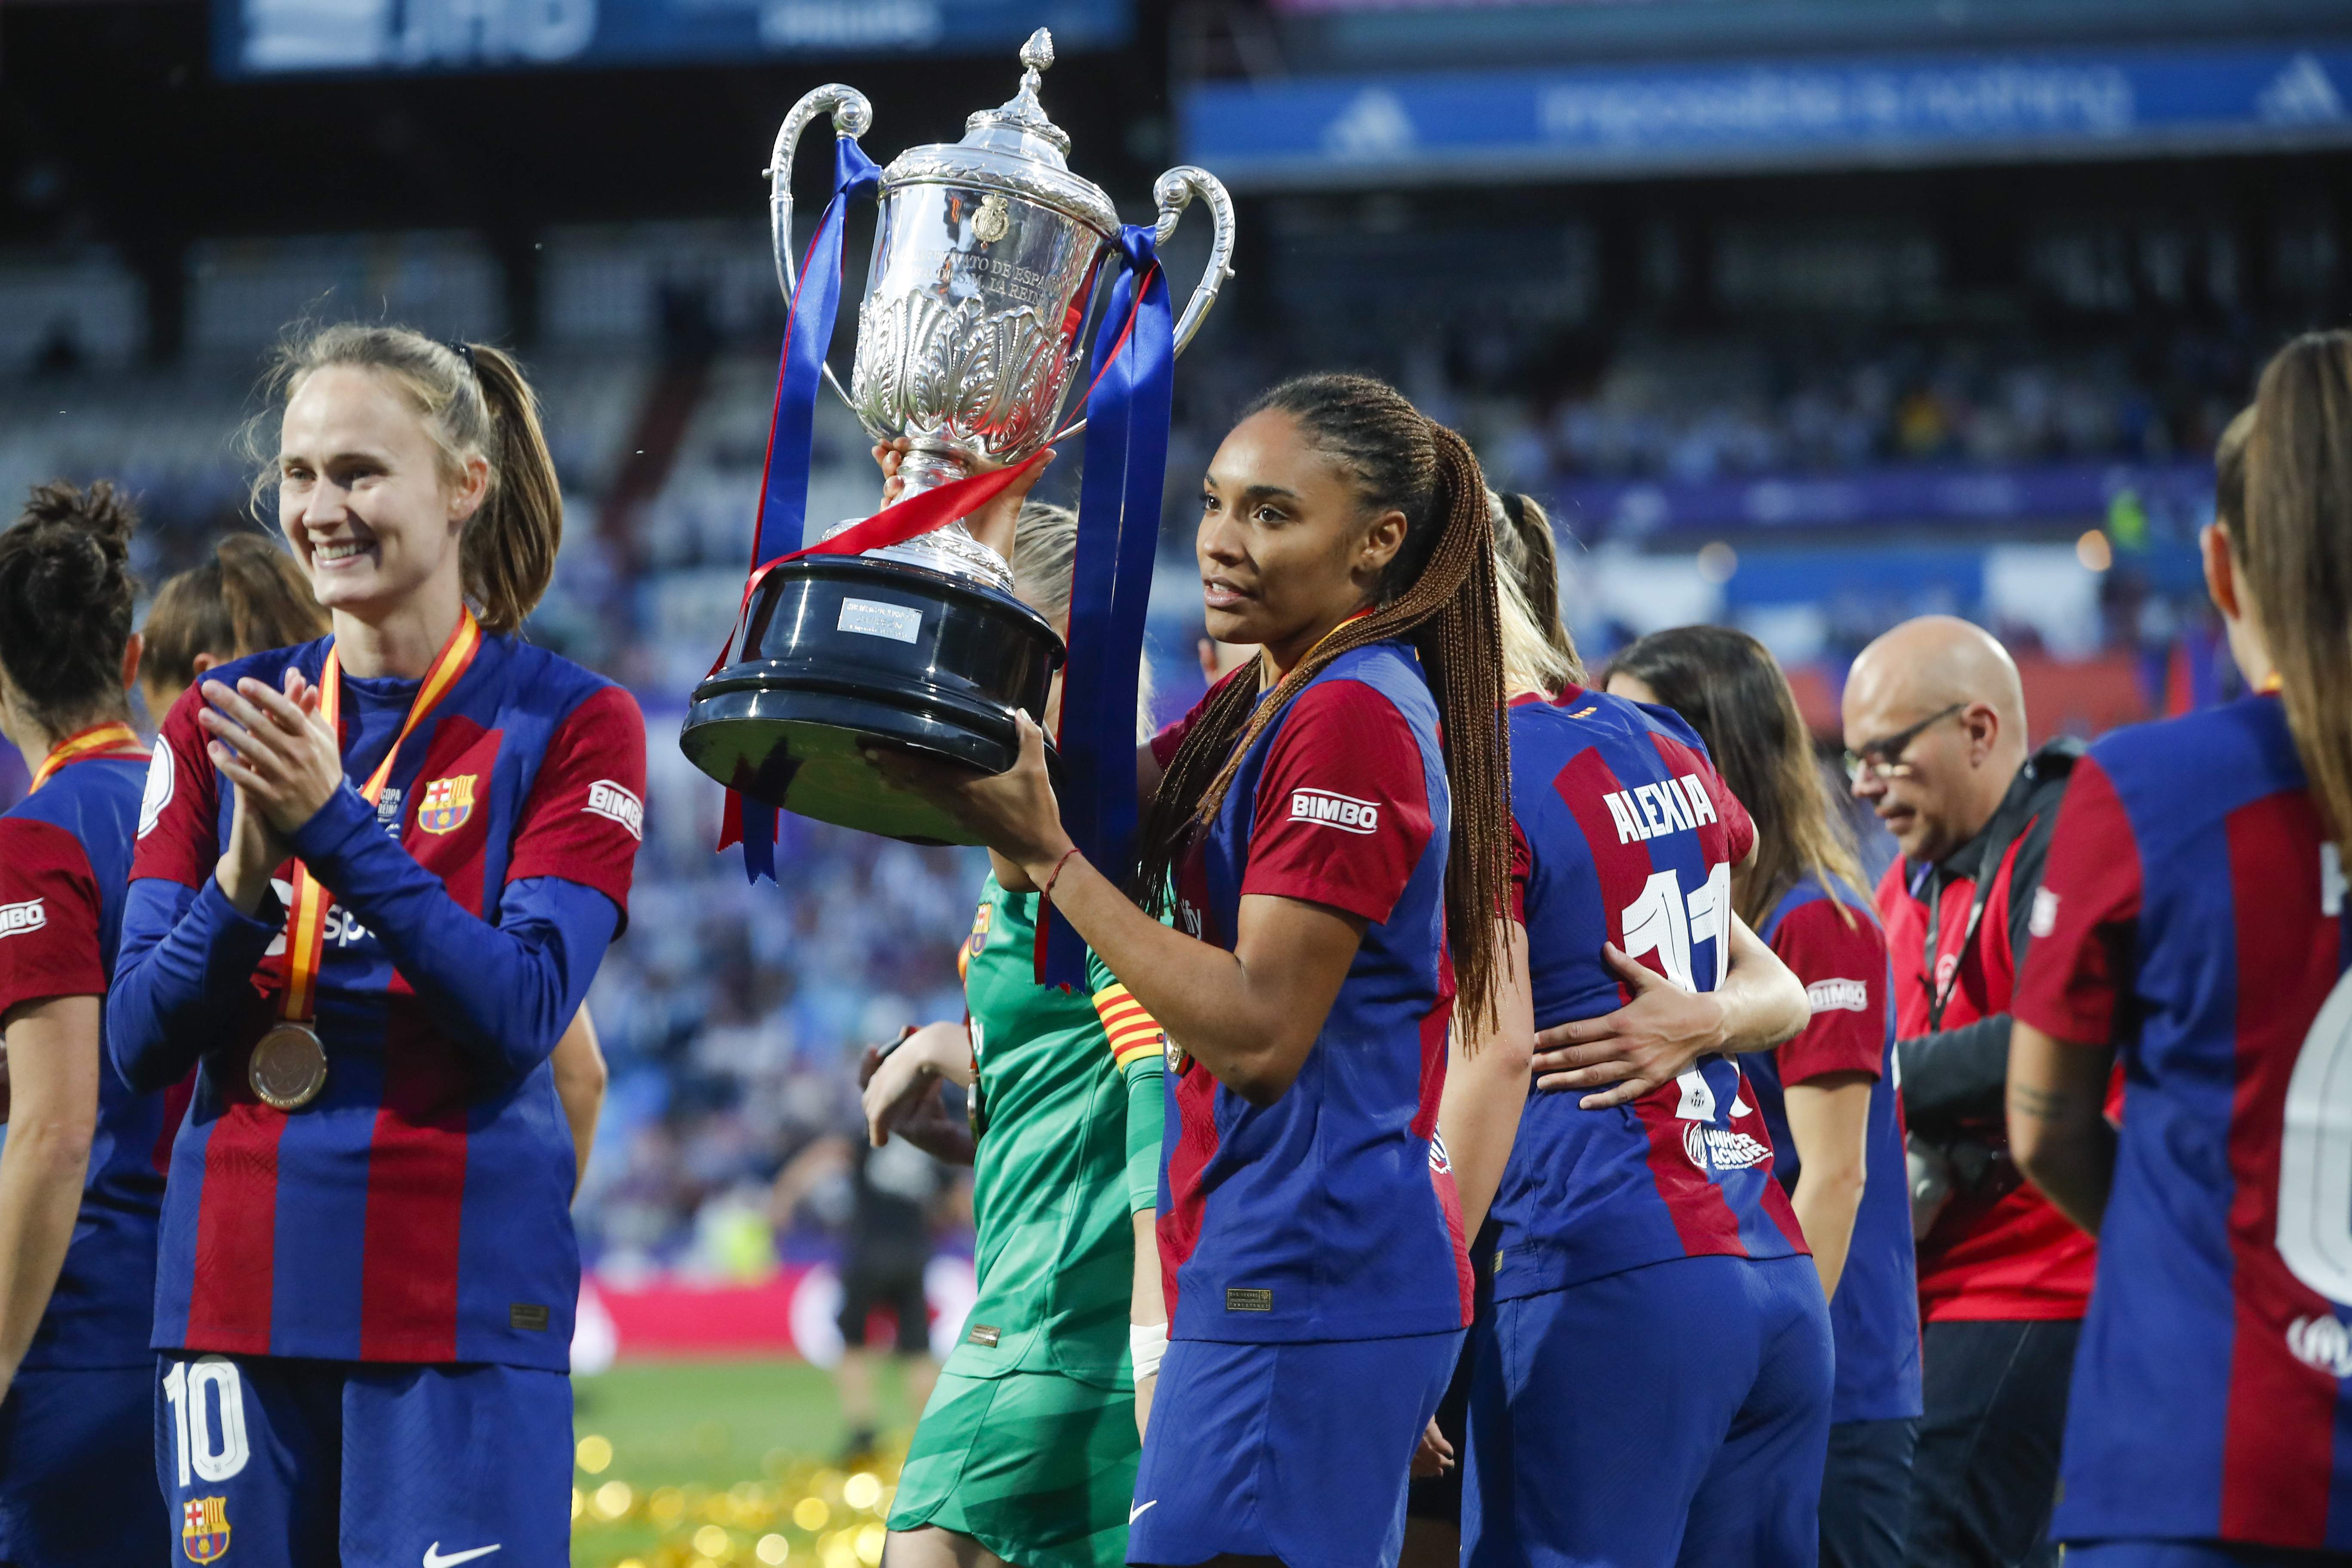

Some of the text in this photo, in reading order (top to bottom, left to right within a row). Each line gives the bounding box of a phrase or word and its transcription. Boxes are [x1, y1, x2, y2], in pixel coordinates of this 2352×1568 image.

[990, 259, 1011, 279] DE
[989, 278, 1006, 295] LA
[380, 788, 401, 802] COPA
[378, 803, 398, 815] REINA
[1291, 794, 1378, 829] BIMBO
[1602, 773, 1718, 845] ALEXIA
[323, 904, 377, 947] Sp
[1621, 861, 1753, 1122] 11
[1807, 984, 1867, 1007] BIMBO
[1703, 1129, 1757, 1149] UNHCR
[1711, 1143, 1769, 1164] ACNUR
[162, 1355, 250, 1488] 10
